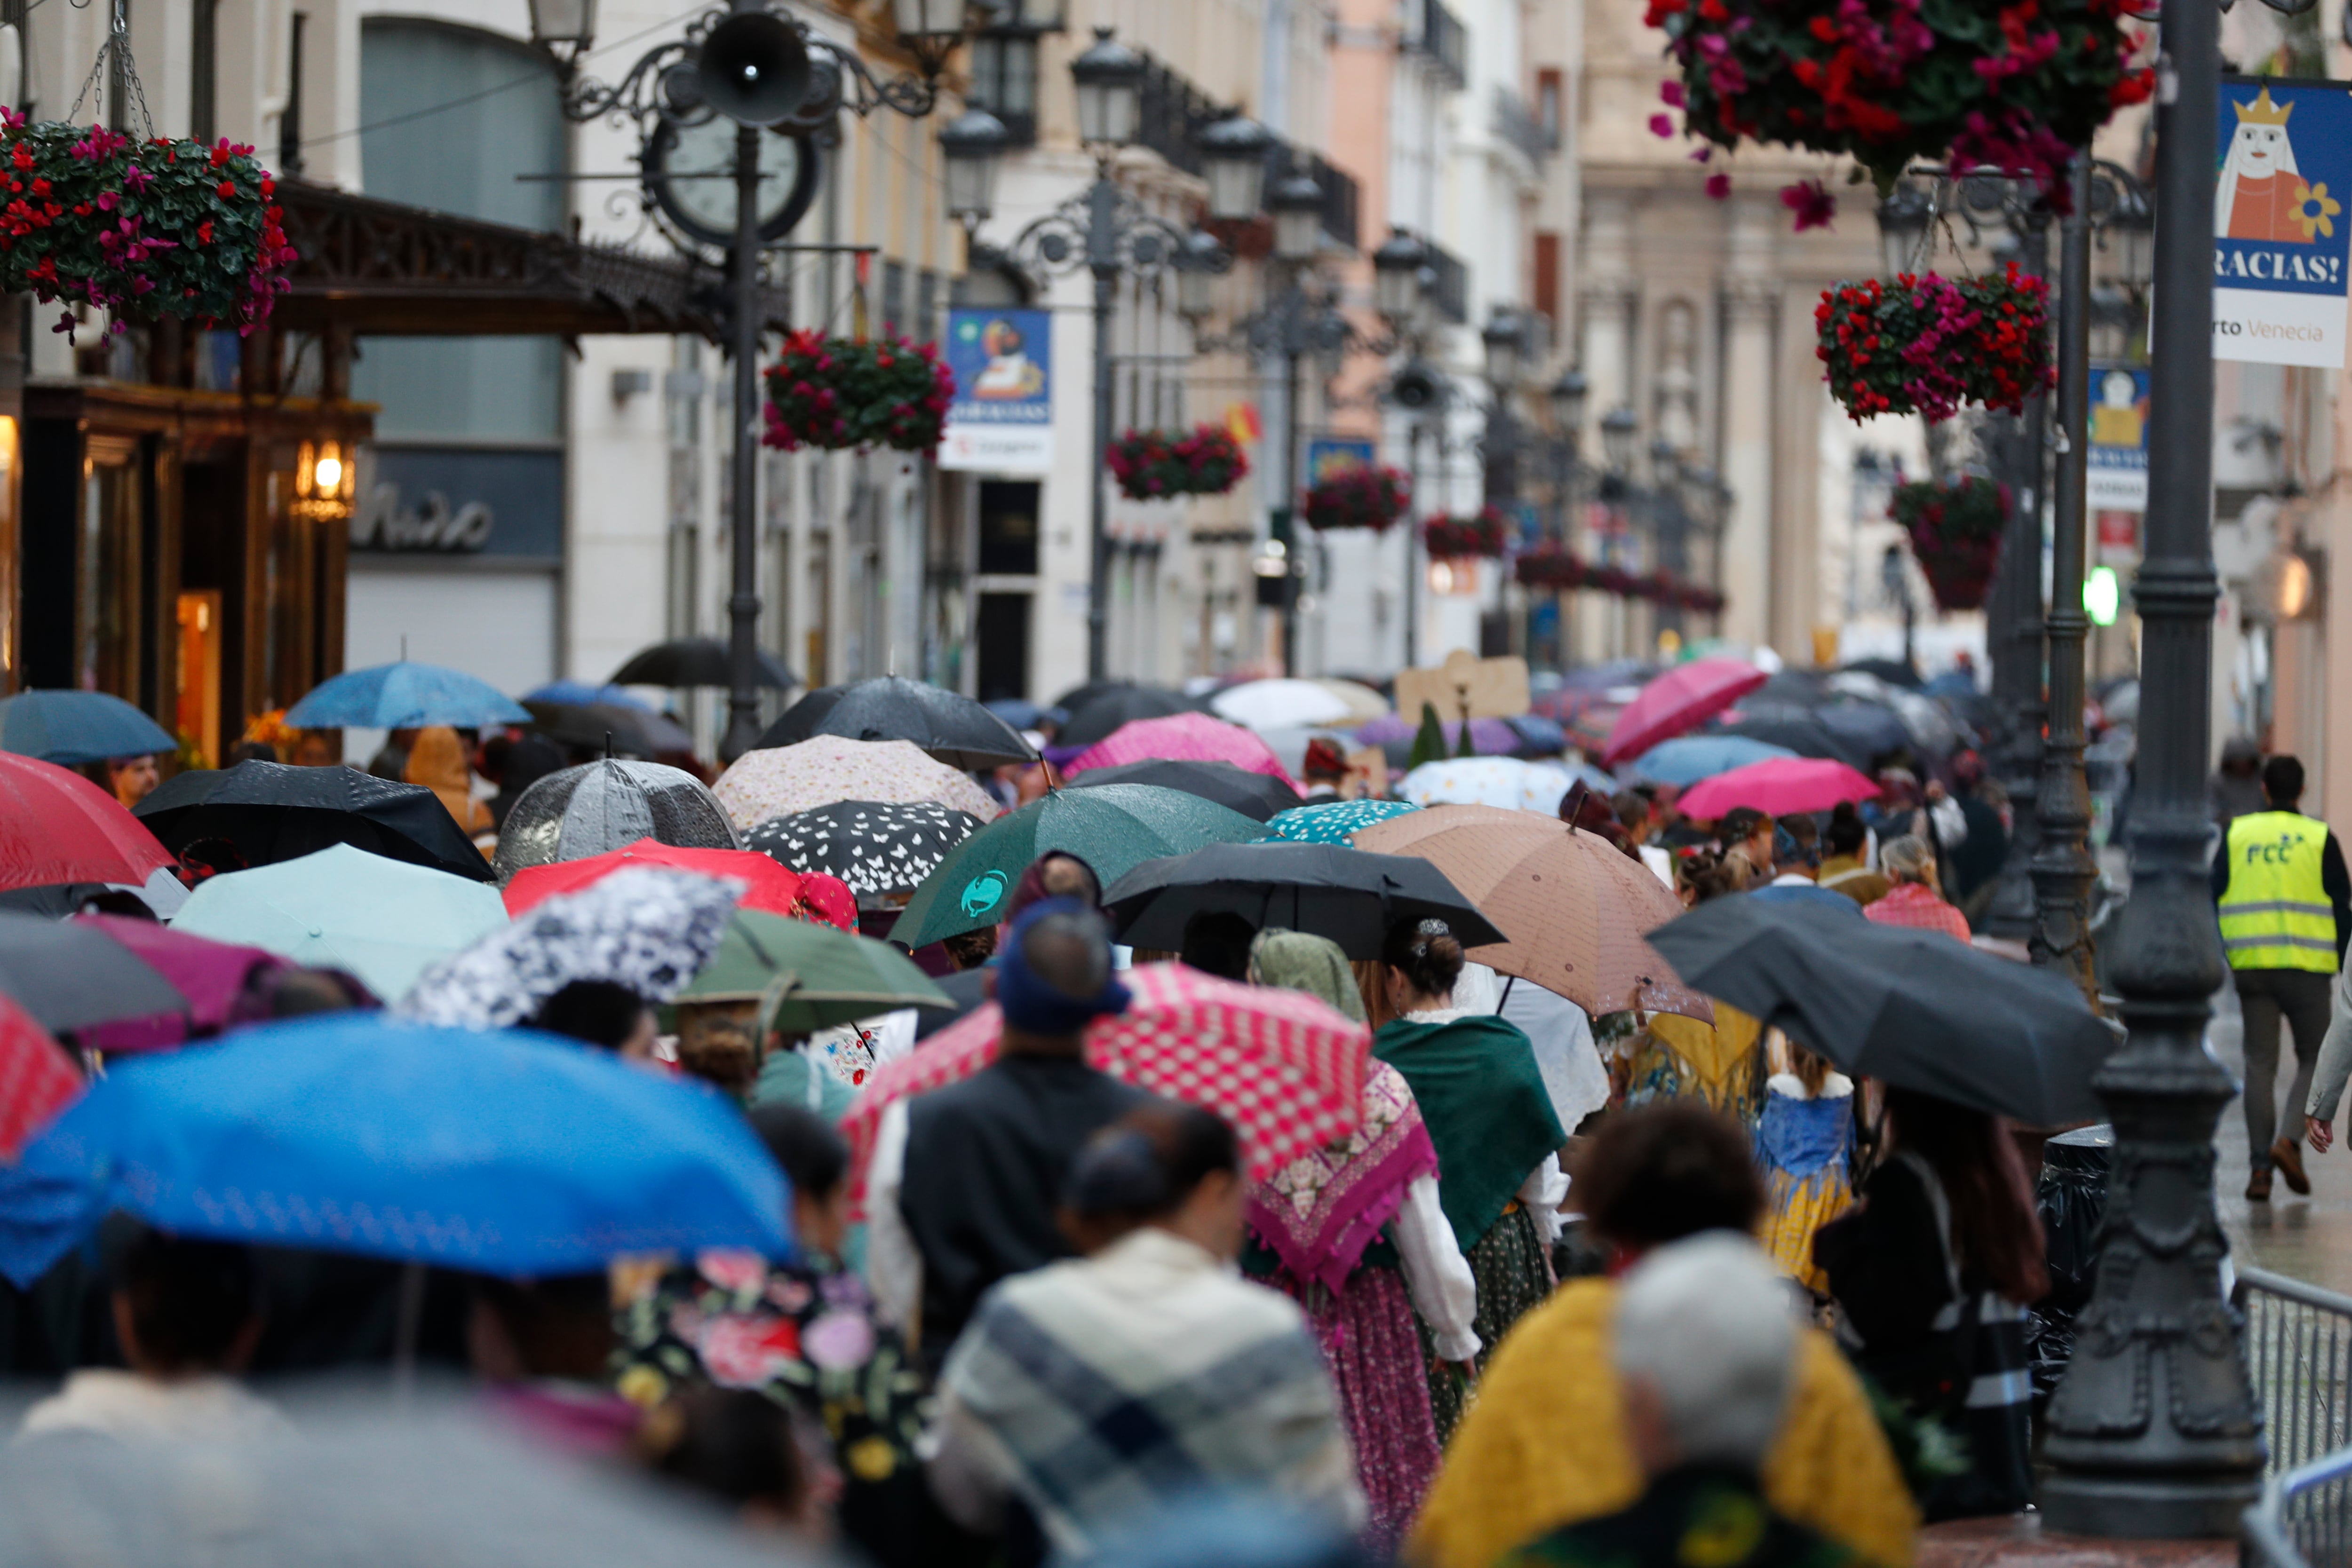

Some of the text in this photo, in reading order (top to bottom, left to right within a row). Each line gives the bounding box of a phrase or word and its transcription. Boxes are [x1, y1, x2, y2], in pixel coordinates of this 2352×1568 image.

[2214, 248, 2340, 284] RACIAS!
[2213, 318, 2323, 342] rto Venecia
